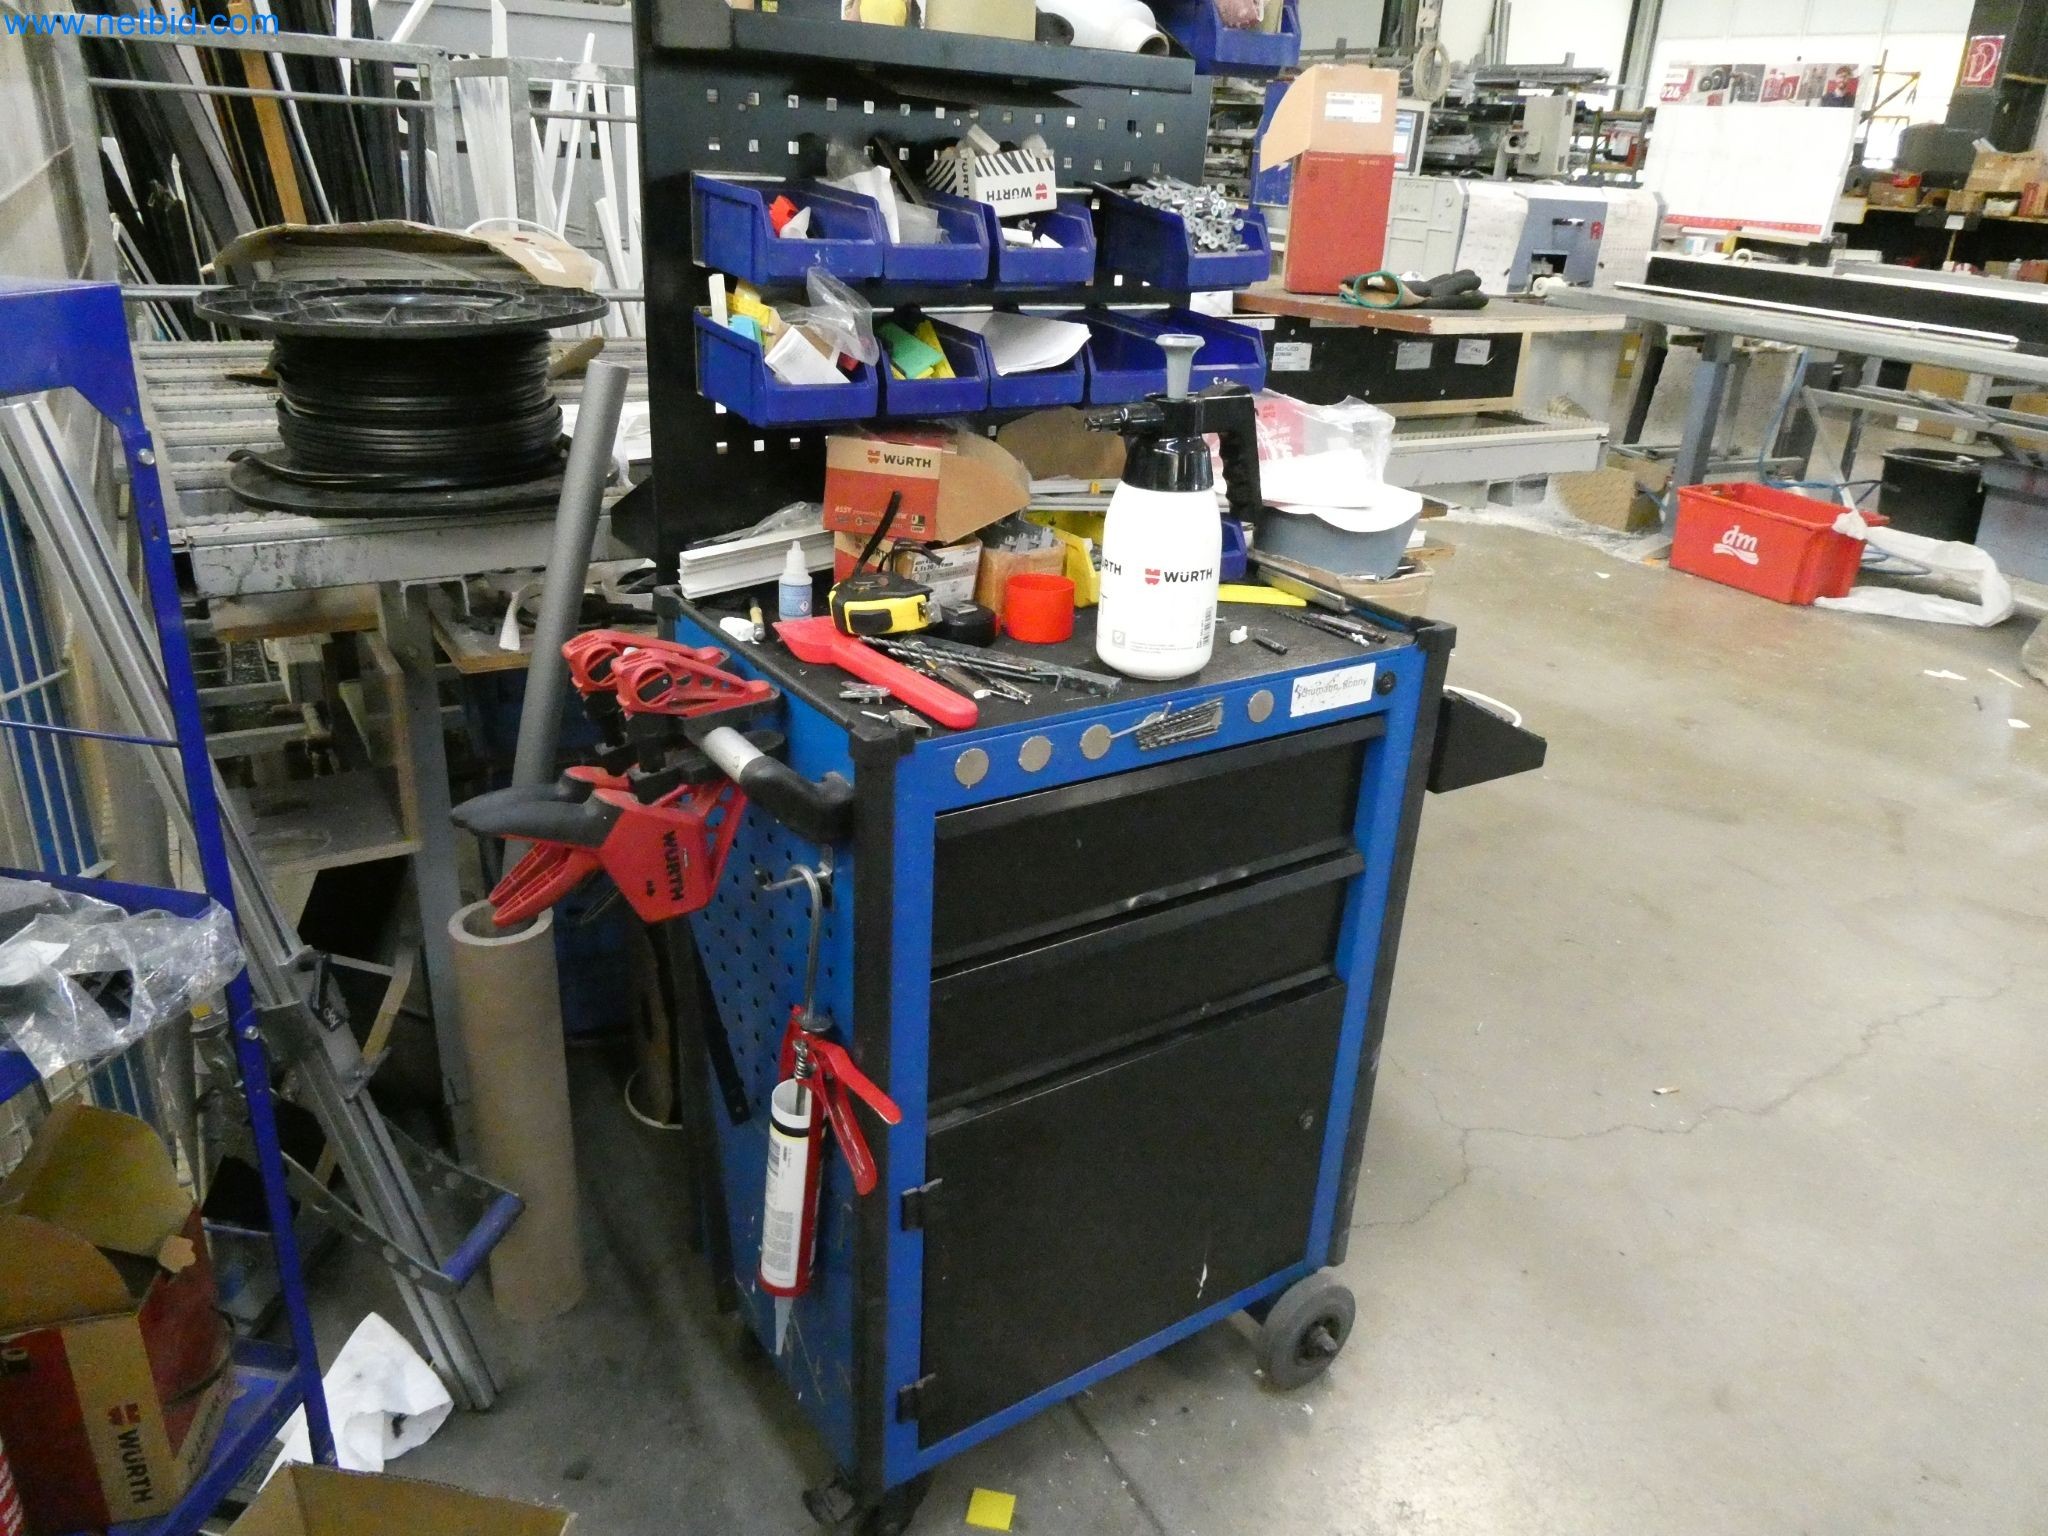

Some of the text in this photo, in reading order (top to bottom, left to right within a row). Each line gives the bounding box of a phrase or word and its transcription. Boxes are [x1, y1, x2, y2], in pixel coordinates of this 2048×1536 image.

[986, 186, 1032, 202] WÜRTH
[883, 453, 932, 468] WÜRTH
[1721, 525, 1758, 552] dm
[1102, 559, 1122, 576] RTH
[1164, 567, 1213, 583] WÜRTH
